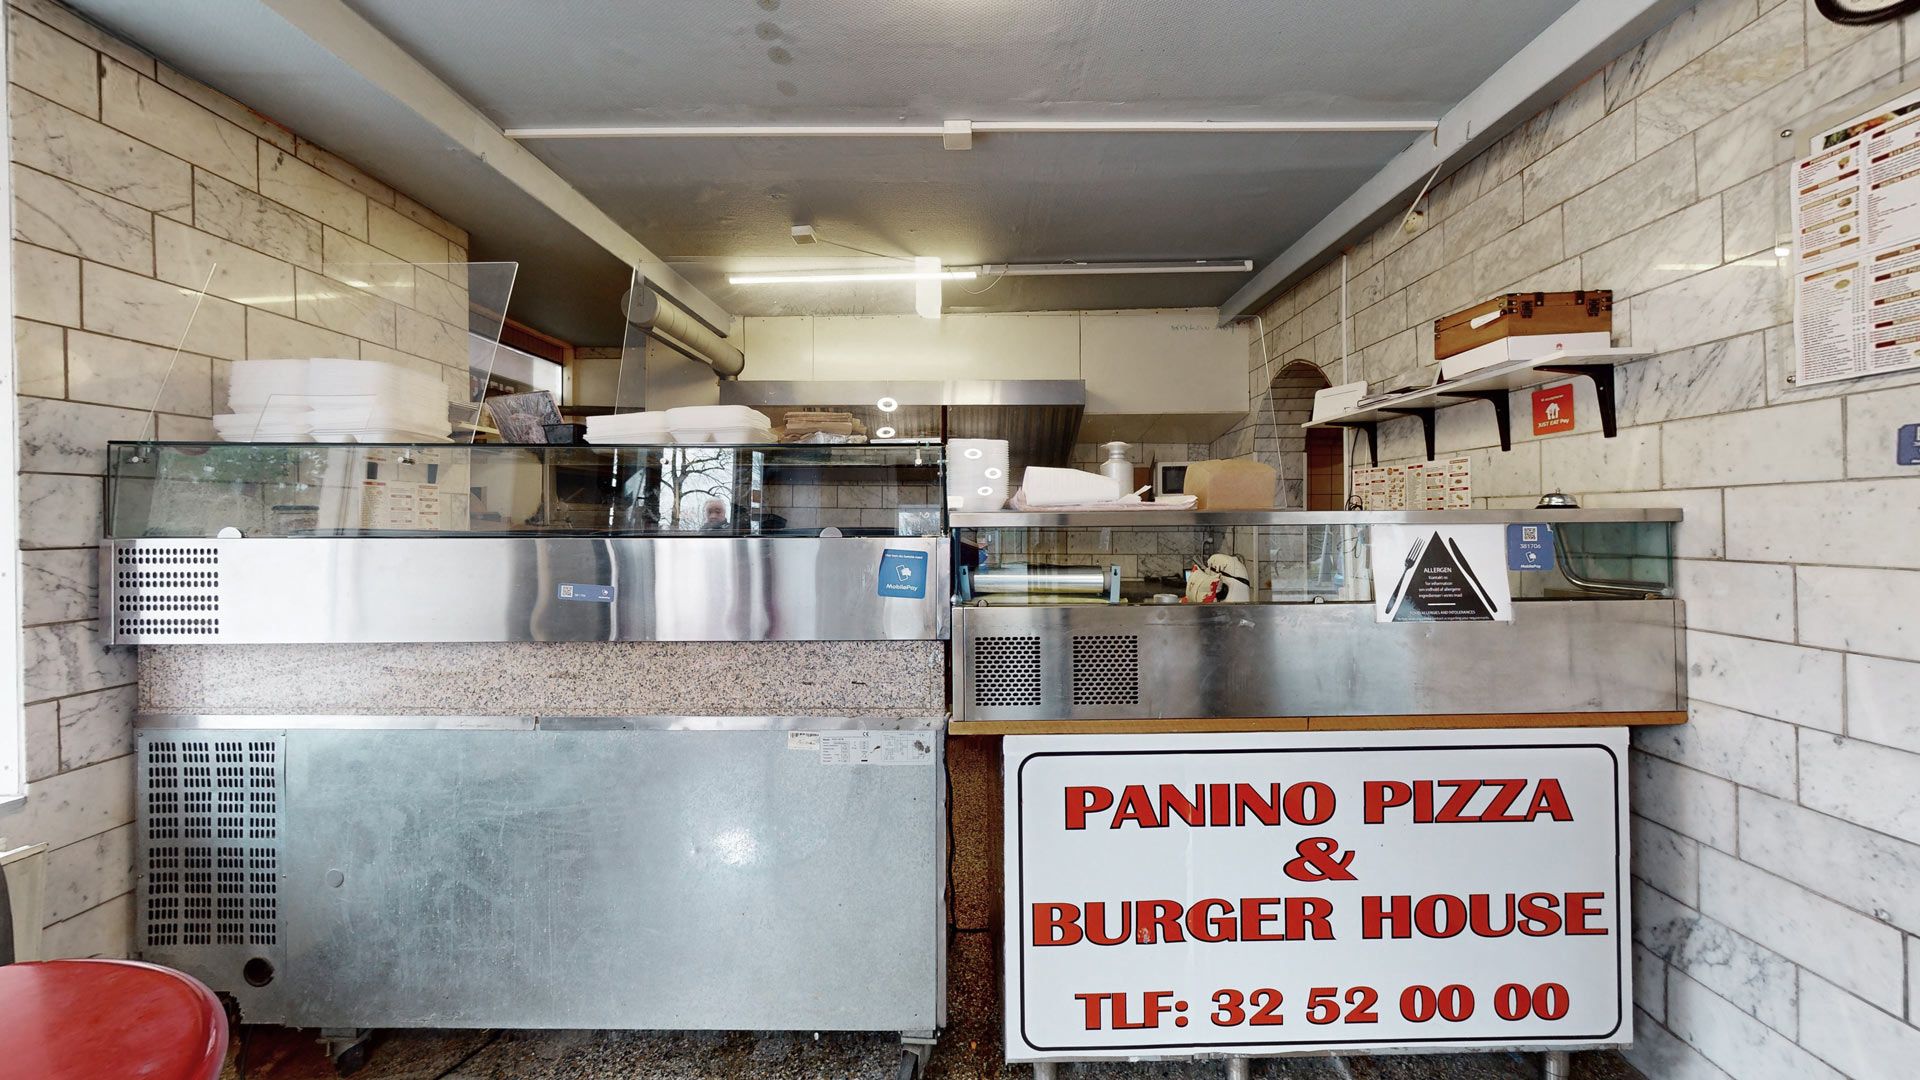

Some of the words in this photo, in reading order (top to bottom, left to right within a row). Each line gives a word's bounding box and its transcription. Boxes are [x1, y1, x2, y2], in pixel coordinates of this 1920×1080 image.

[885, 583, 918, 591] MobilePay
[1064, 781, 1336, 830] PANINO
[1363, 778, 1574, 825] PIZZA
[1283, 837, 1358, 882] &
[1032, 897, 1336, 947] BURGER
[1361, 892, 1609, 940] HOUSE
[1074, 990, 1189, 1031] TLF:
[1210, 988, 1284, 1027] 32
[1306, 986, 1379, 1025] 52
[1400, 984, 1475, 1023] 00
[1494, 983, 1570, 1022] 00
